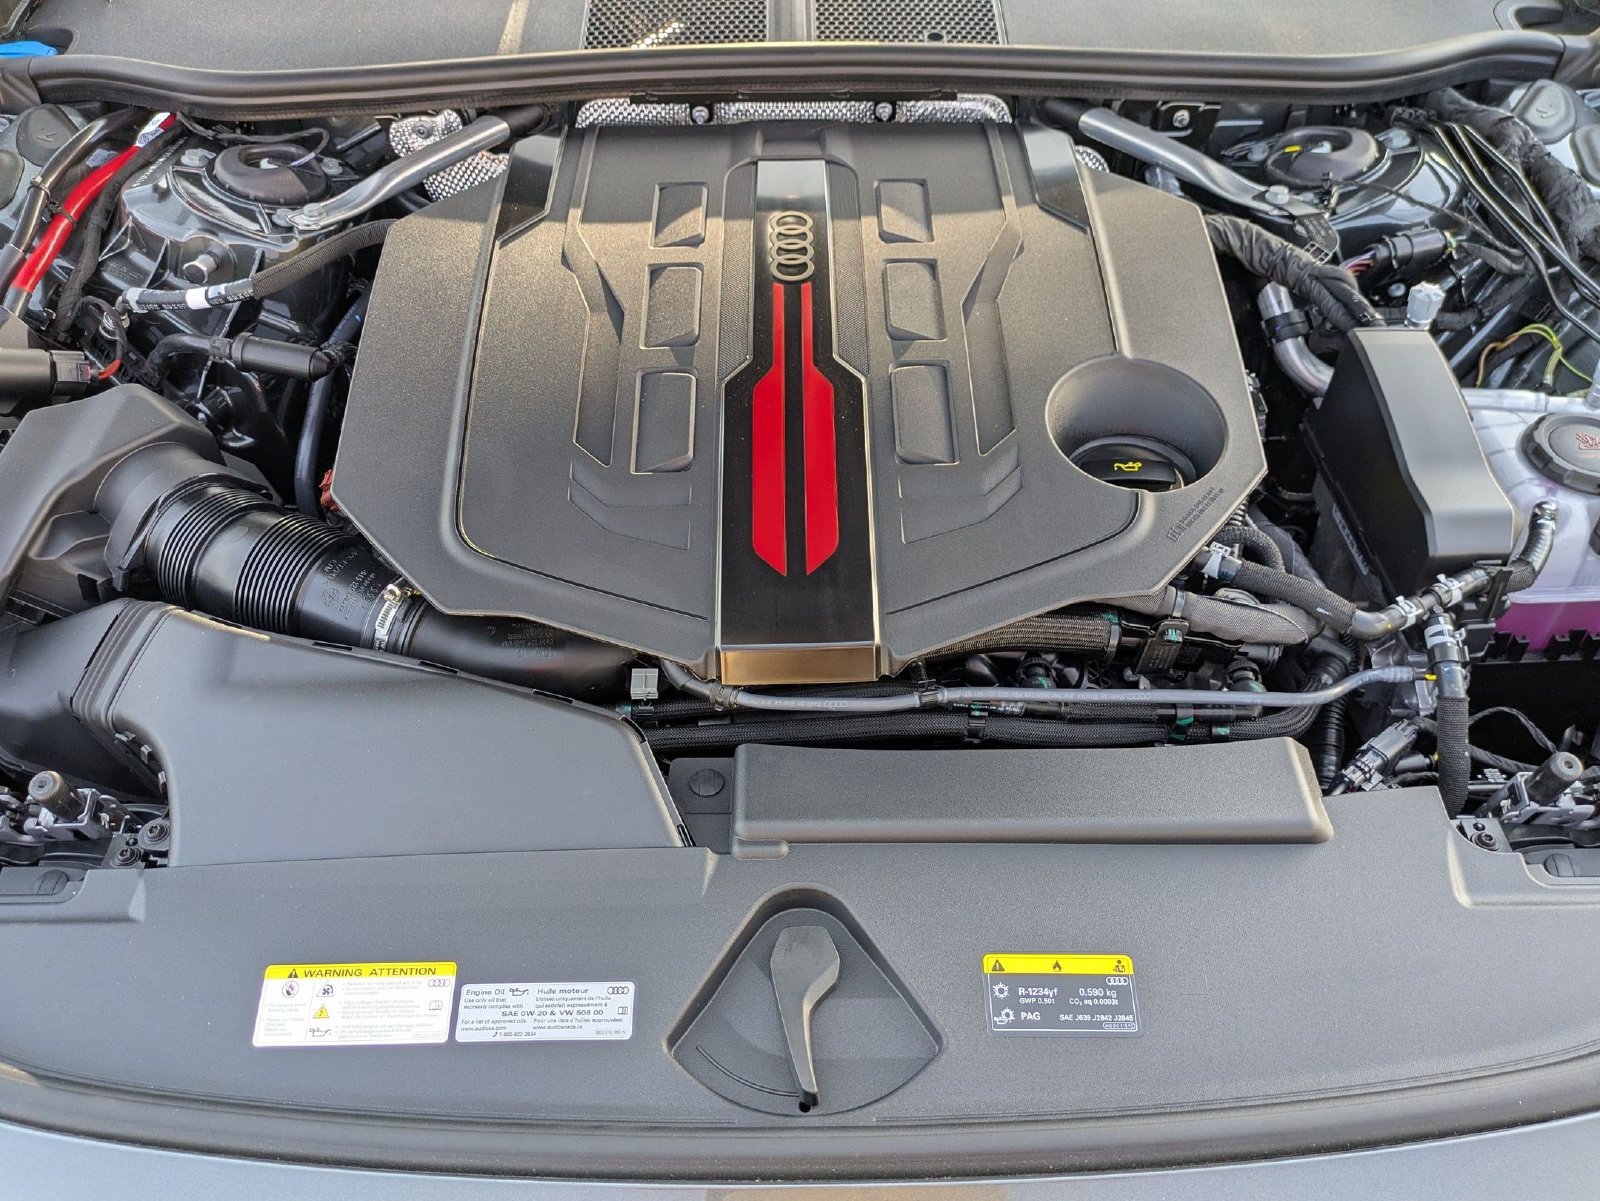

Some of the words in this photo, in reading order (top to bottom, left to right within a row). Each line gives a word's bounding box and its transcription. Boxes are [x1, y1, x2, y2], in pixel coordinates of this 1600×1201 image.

[304, 968, 362, 977] WARNING
[369, 967, 436, 976] ATTENTION
[1018, 987, 1058, 997] R-1234yf
[1079, 987, 1104, 996] 0.590
[1106, 987, 1117, 998] kg
[1020, 1011, 1041, 1020] PAG
